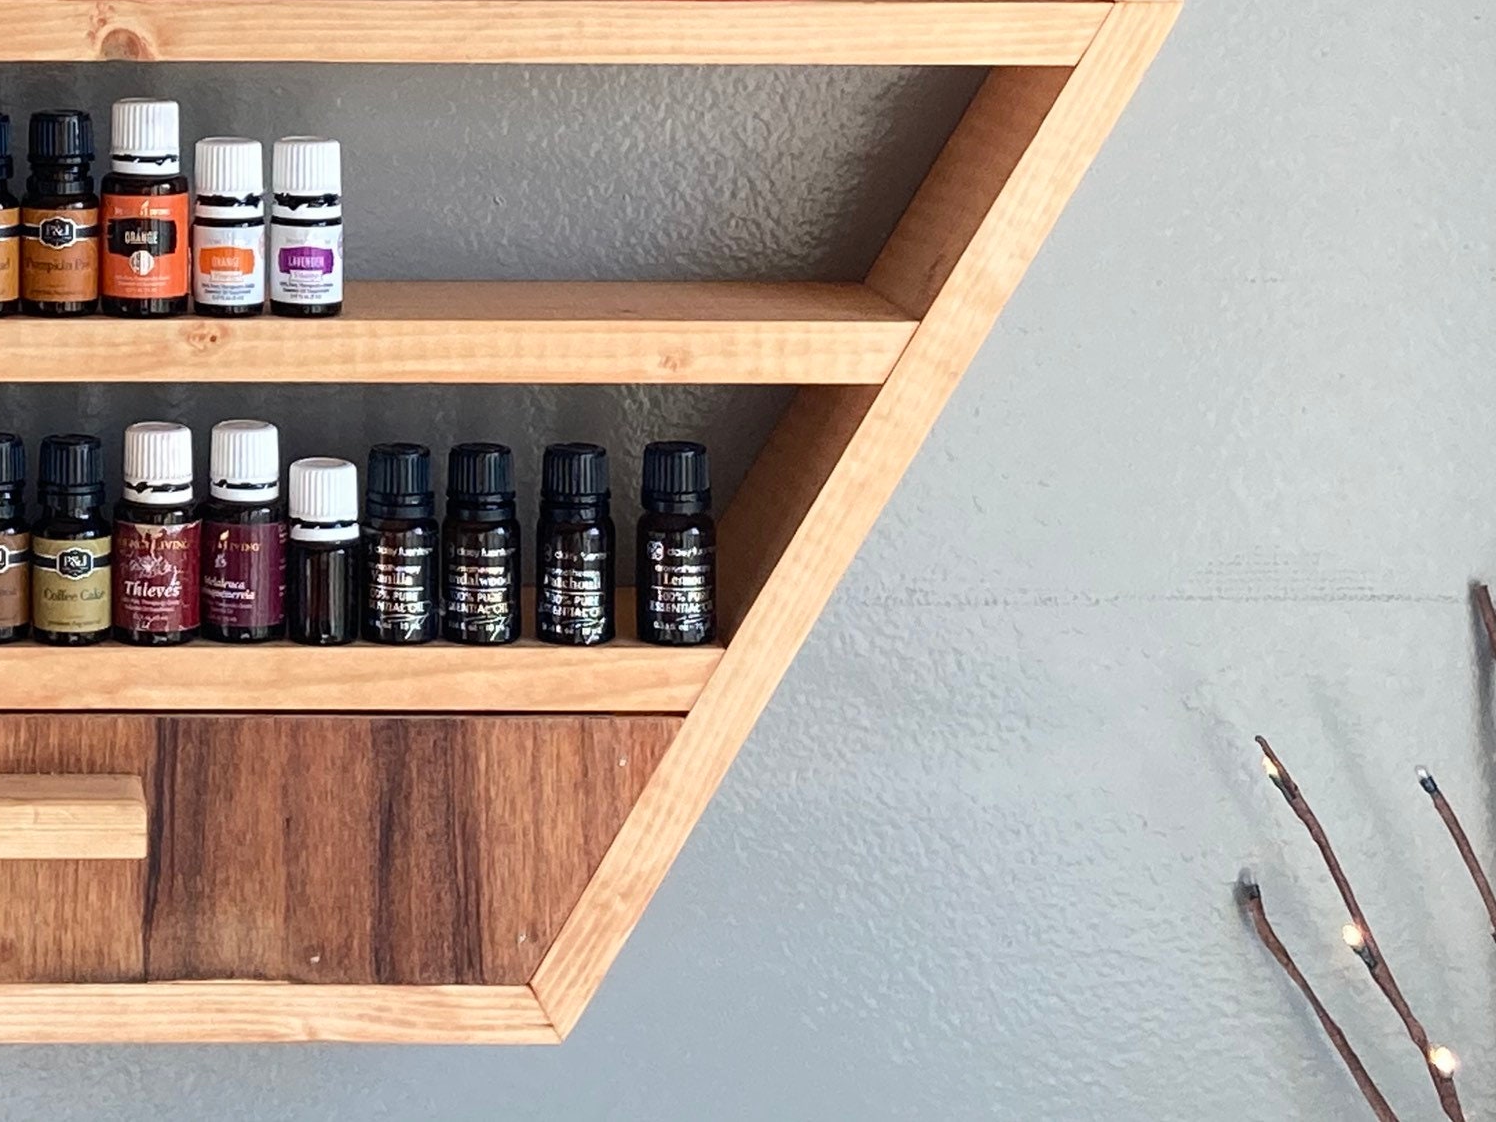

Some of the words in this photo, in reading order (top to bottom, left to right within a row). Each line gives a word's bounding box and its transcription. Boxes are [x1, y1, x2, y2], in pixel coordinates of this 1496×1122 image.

[124, 228, 159, 245] ORANGE
[288, 256, 325, 268] LAVENDER
[44, 587, 78, 601] Coffee
[80, 587, 106, 601] Cake
[124, 580, 183, 598] Thieves
